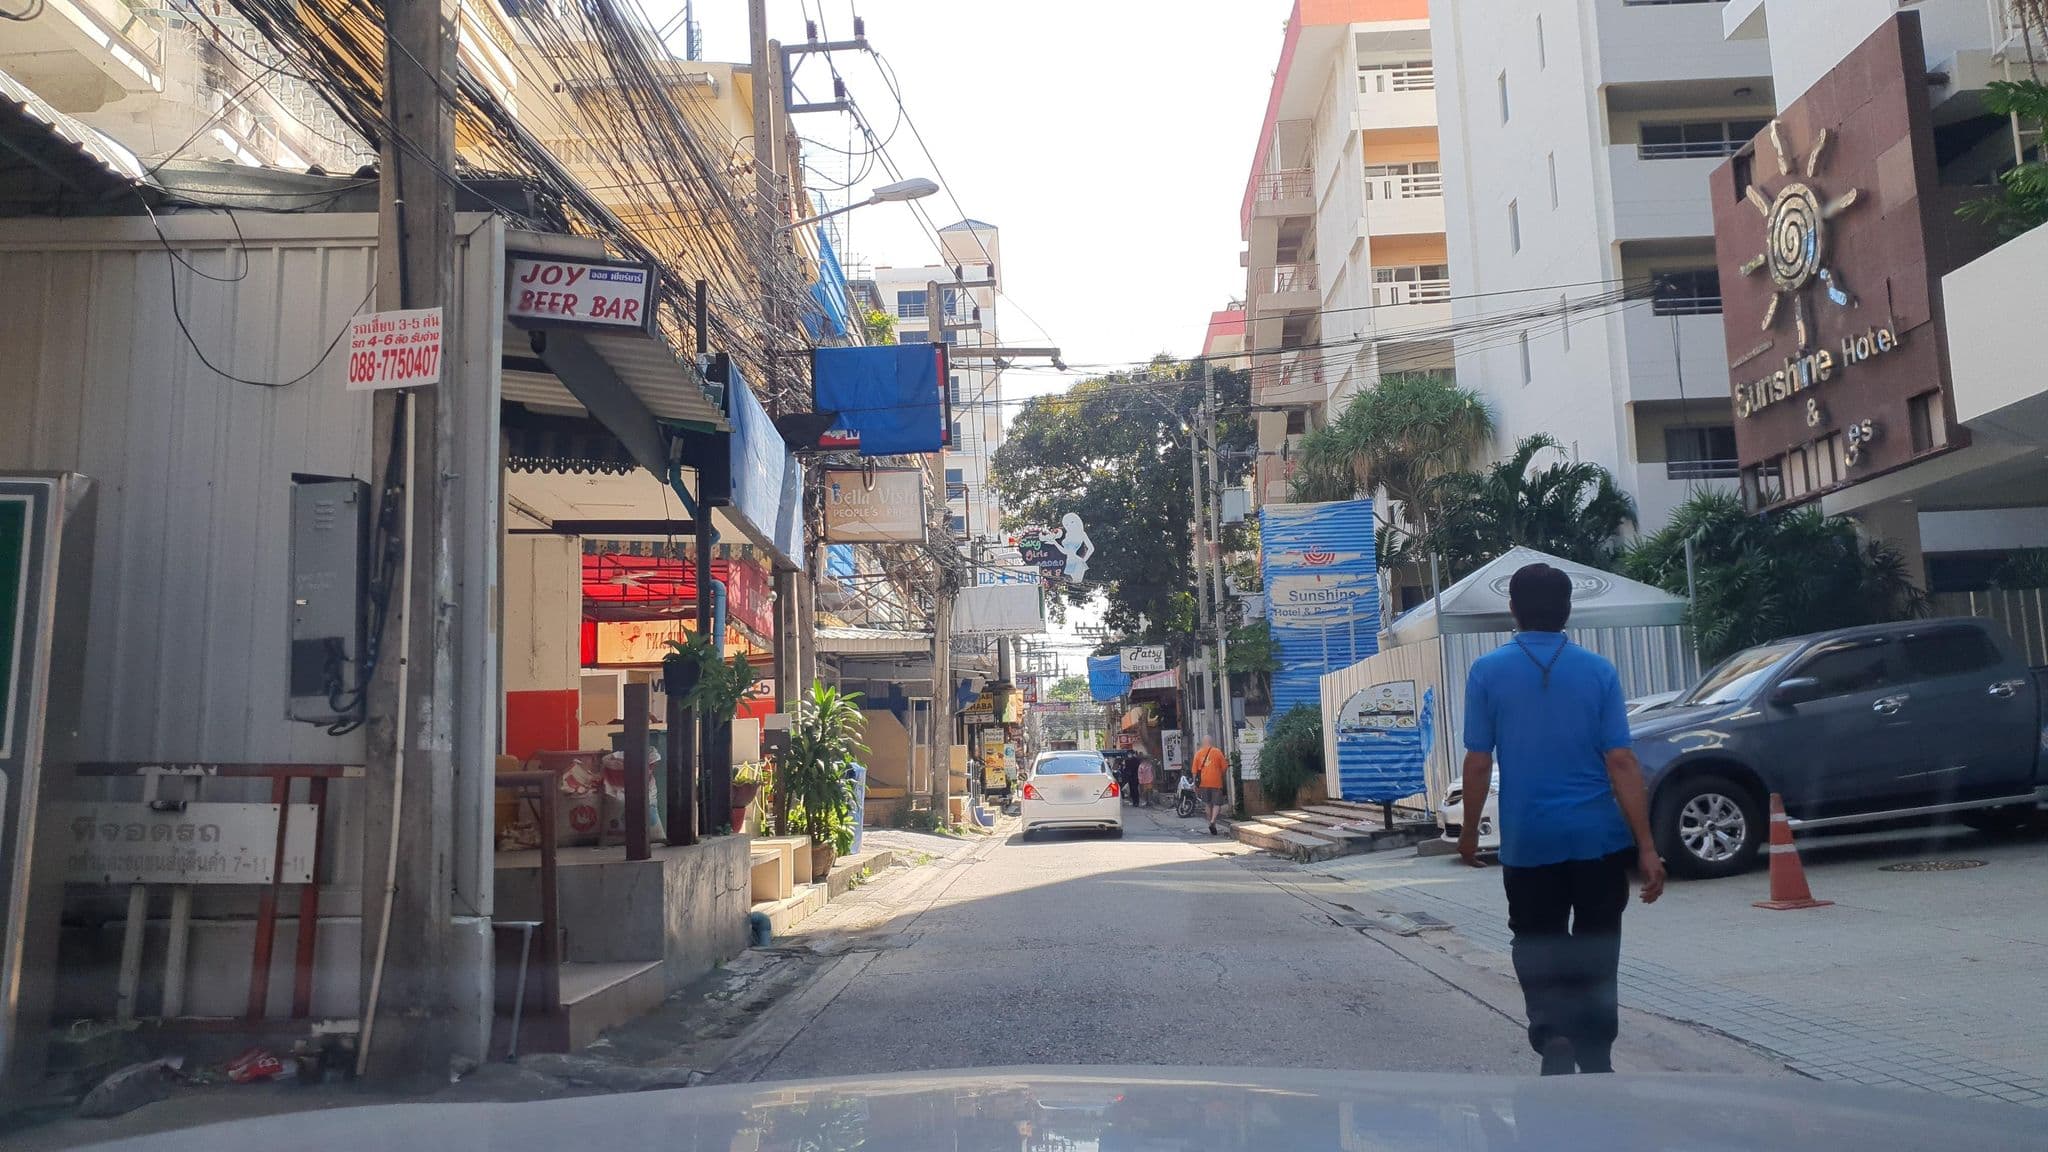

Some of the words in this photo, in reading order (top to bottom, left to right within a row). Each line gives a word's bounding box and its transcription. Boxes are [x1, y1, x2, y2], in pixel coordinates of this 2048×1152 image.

[521, 264, 586, 286] JOY
[518, 290, 578, 316] BEER
[589, 295, 640, 321] BAR
[399, 318, 420, 330] 3-5
[368, 334, 393, 347] 4-6
[350, 344, 439, 383] 088-7750407
[1734, 349, 1833, 419] Sunshine
[1841, 319, 1898, 368] Hotel
[1806, 398, 1820, 427] &
[1288, 589, 1357, 602] Sunshine
[1130, 647, 1162, 662] Patsy
